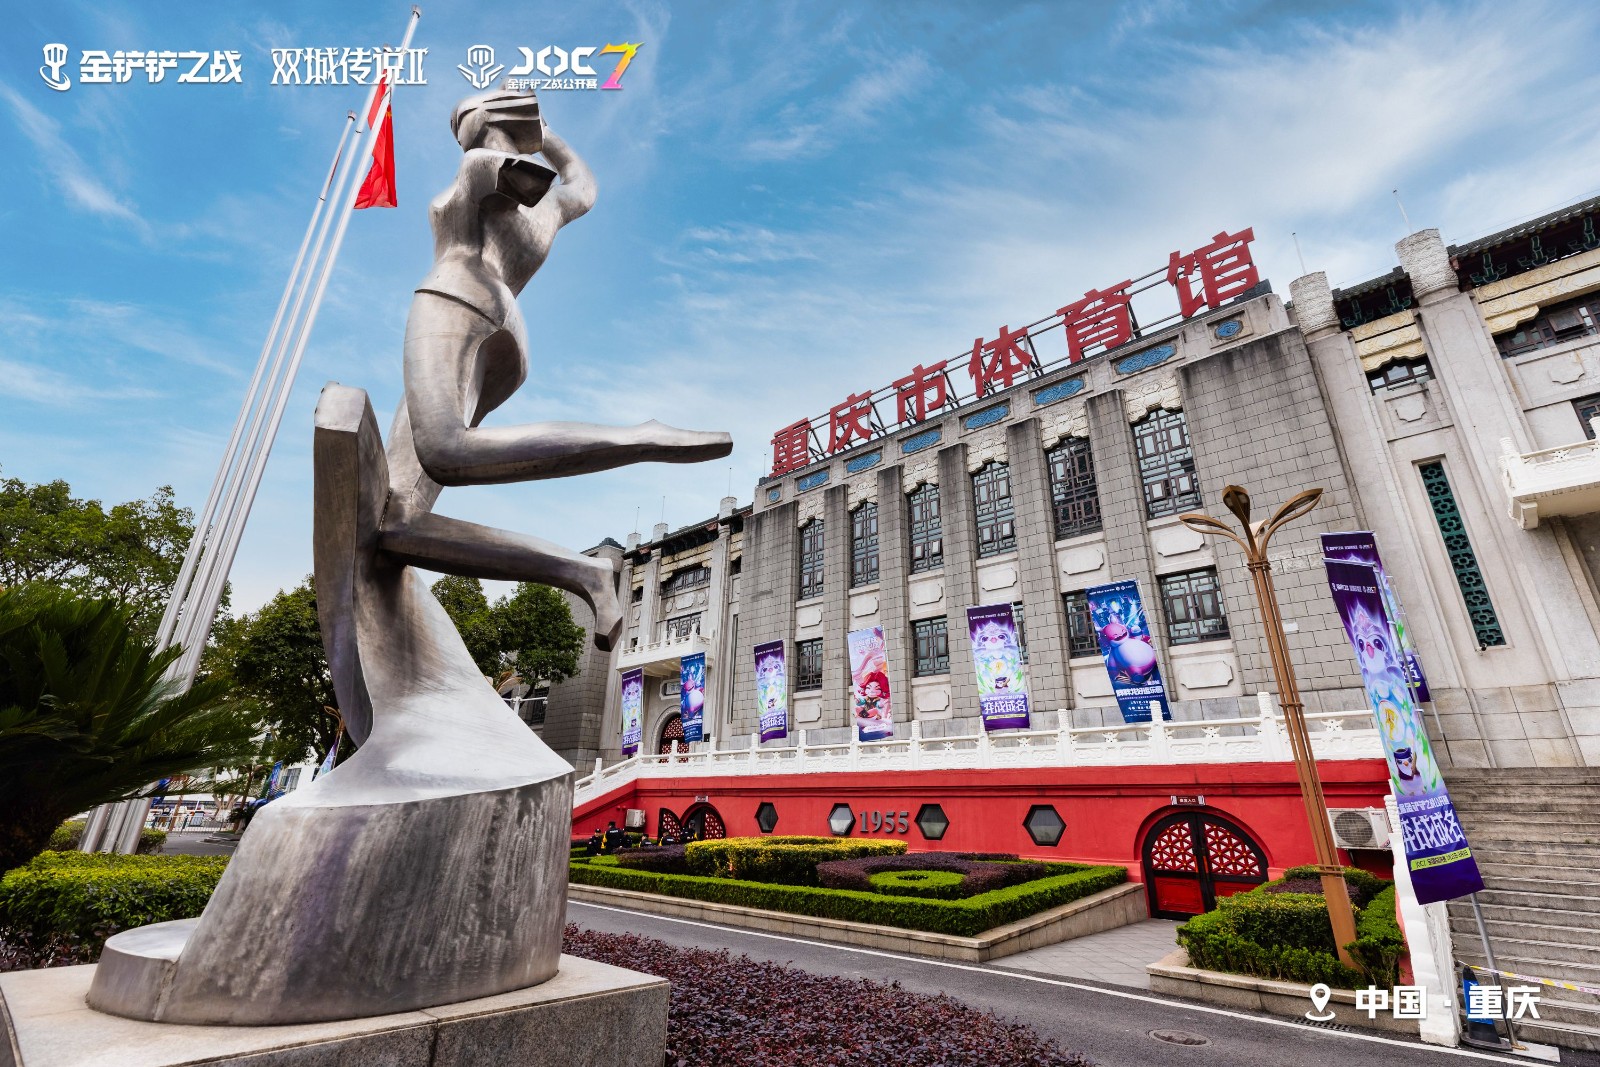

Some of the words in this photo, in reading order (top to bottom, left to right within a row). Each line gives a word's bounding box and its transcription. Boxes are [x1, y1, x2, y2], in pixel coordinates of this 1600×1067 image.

[770, 227, 1259, 478] 重庆市体育馆
[860, 811, 909, 833] 1955
